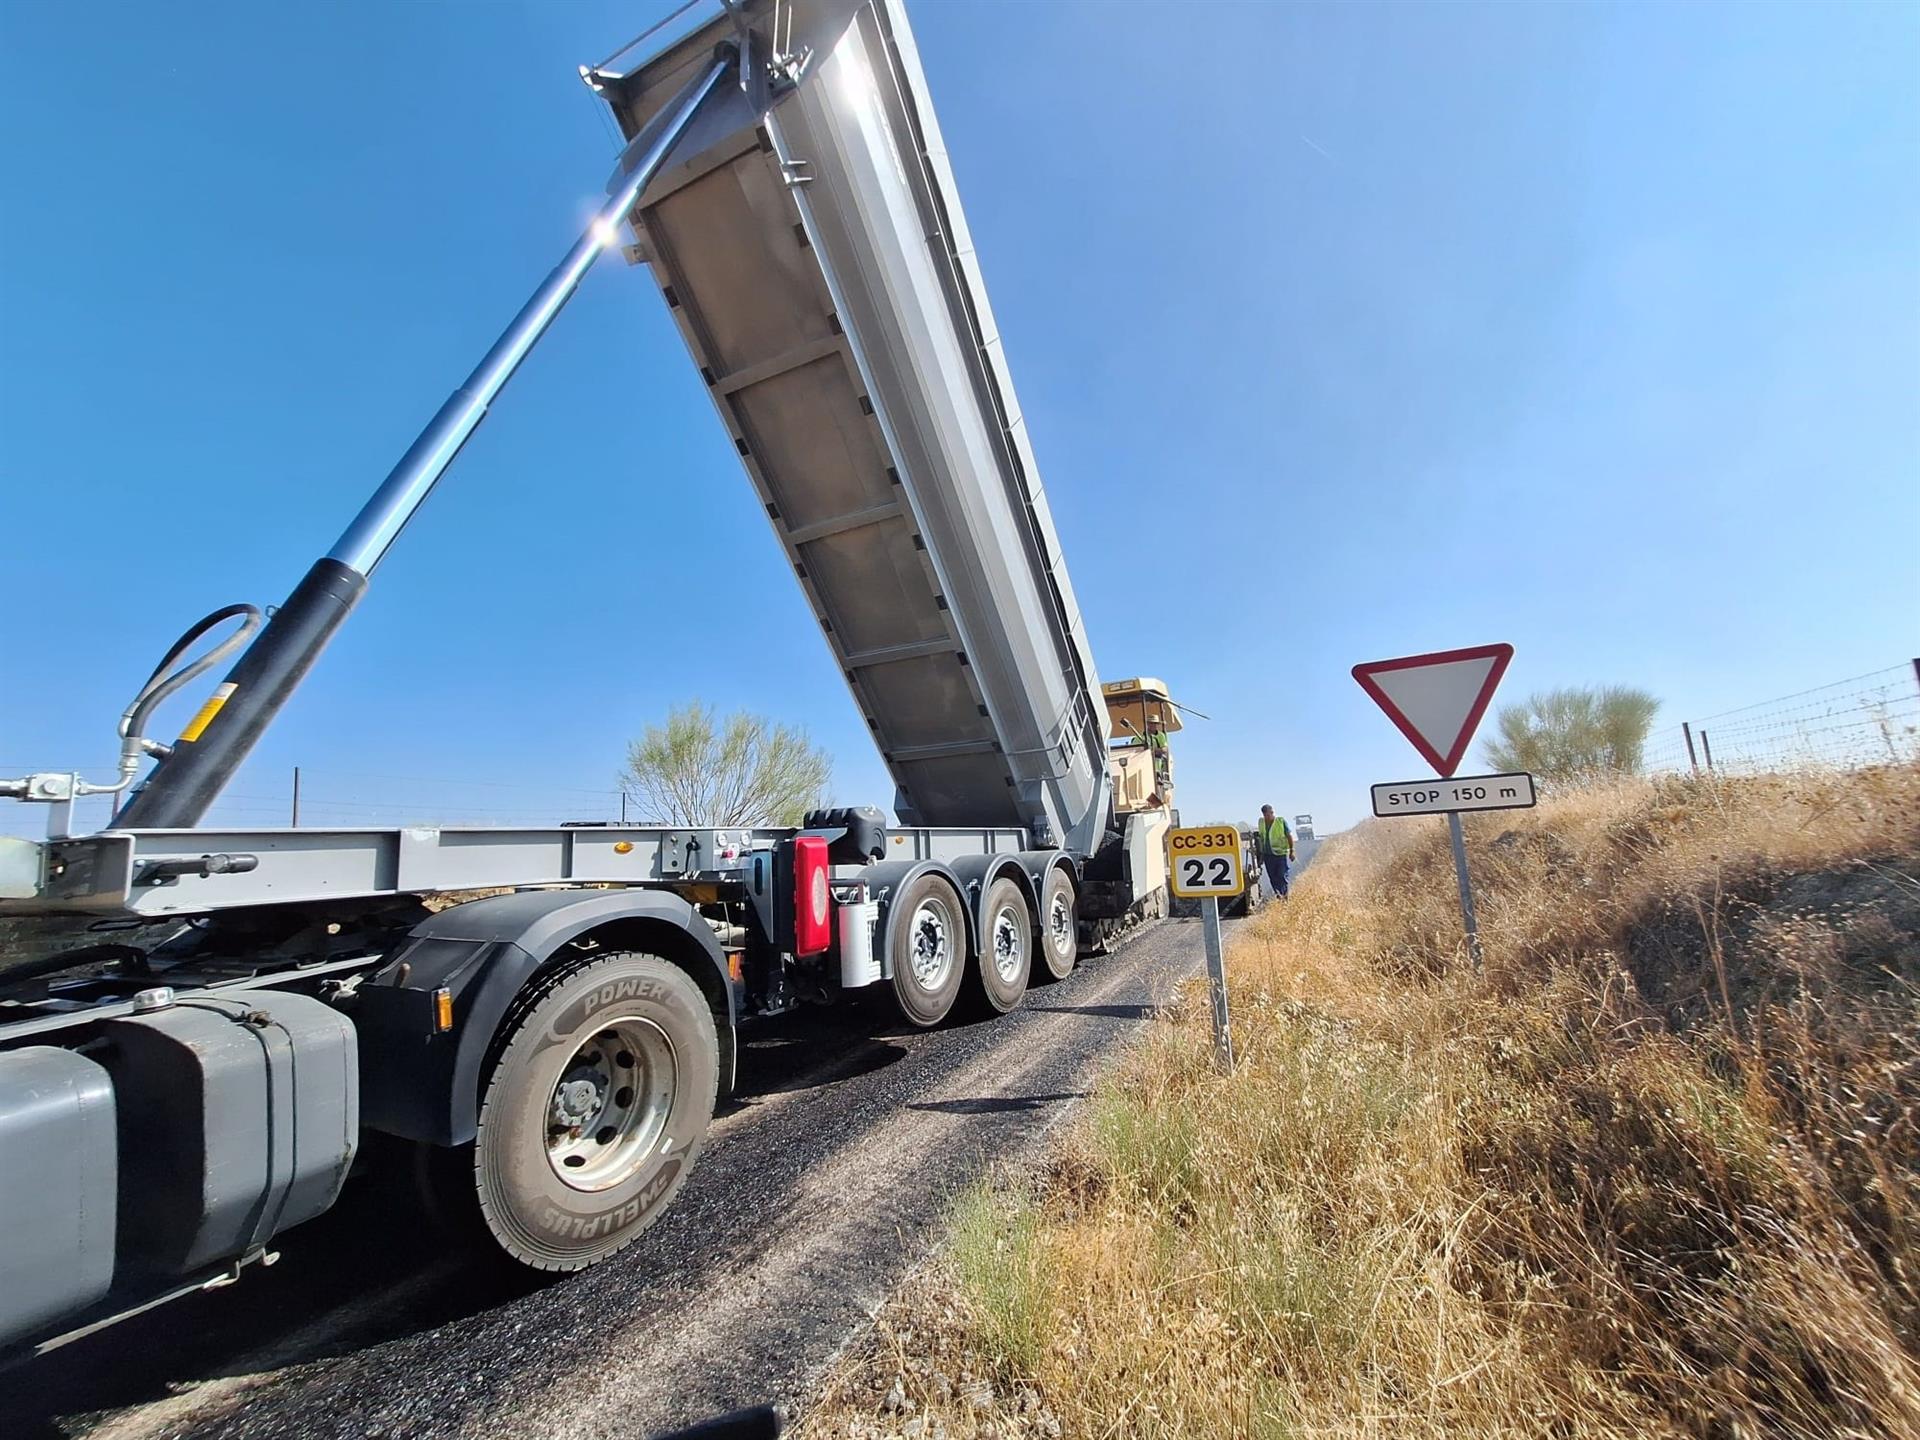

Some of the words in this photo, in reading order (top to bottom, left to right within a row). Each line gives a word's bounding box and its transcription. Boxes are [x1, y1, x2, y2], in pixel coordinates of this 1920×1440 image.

[1388, 790, 1440, 805] STOP
[1452, 787, 1487, 801] 150
[1500, 787, 1517, 798] m
[1172, 832, 1234, 850] CC-331
[1183, 858, 1232, 887] 22
